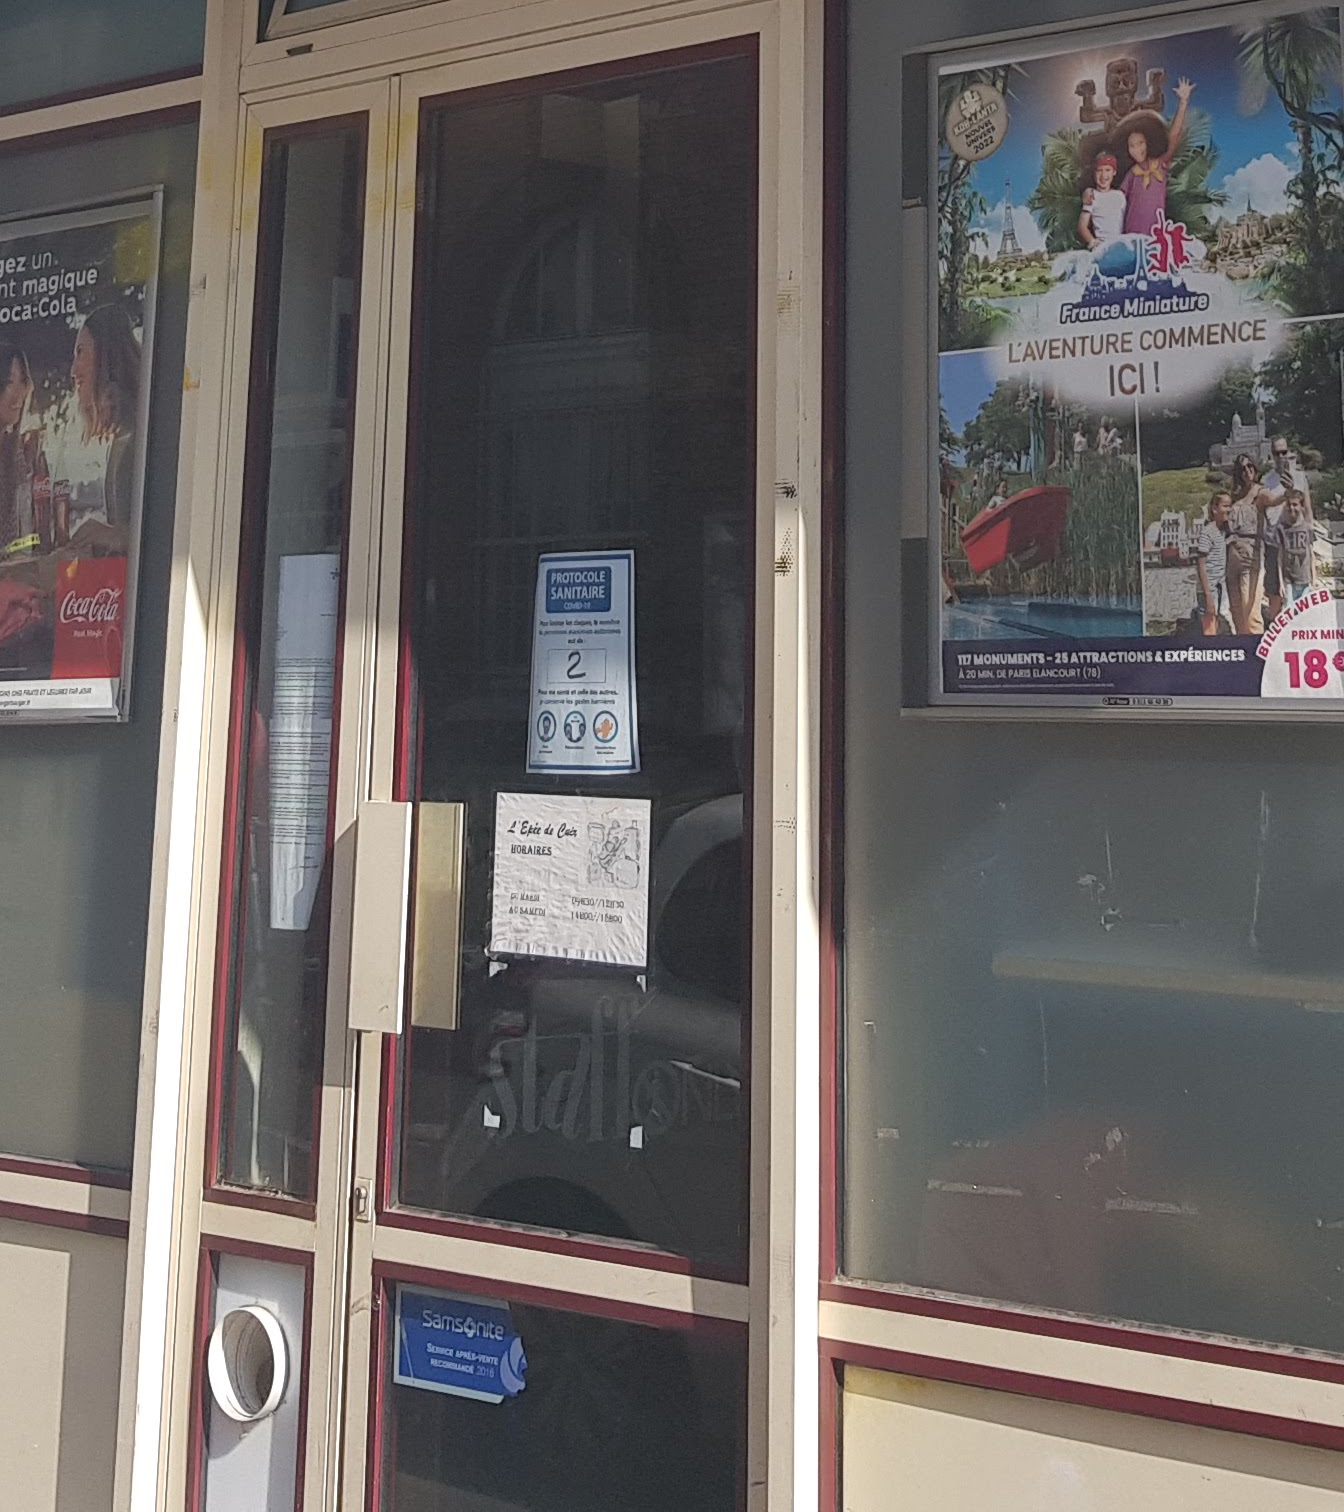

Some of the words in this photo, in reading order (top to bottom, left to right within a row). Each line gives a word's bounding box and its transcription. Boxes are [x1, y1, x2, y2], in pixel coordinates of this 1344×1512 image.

[973, 136, 994, 154] 2022
[22, 268, 98, 296] magique
[1060, 303, 1122, 324] France
[1123, 293, 1208, 317] Miniature
[1008, 332, 1133, 363] L'AVENTURE
[1139, 319, 1267, 350] COMMENCE
[1109, 362, 1145, 397] ICI
[551, 571, 606, 585] PROTOCOLE
[550, 585, 606, 600] SANITAIRE
[1258, 608, 1293, 657] BILLET
[1295, 590, 1330, 613] WEB
[1291, 630, 1318, 640] PRIX
[566, 651, 586, 679] 2
[973, 653, 1045, 665] MONUMENTS
[1070, 650, 1154, 664] ATTRACTIONS
[1164, 647, 1245, 662] EXPÉRIENCES
[966, 669, 976, 678] 20
[996, 669, 1006, 678] DE
[1008, 669, 1031, 678] PARIS
[544, 824, 554, 835] de
[511, 844, 552, 856] HORAIRES
[422, 1309, 504, 1340] Samsonite
